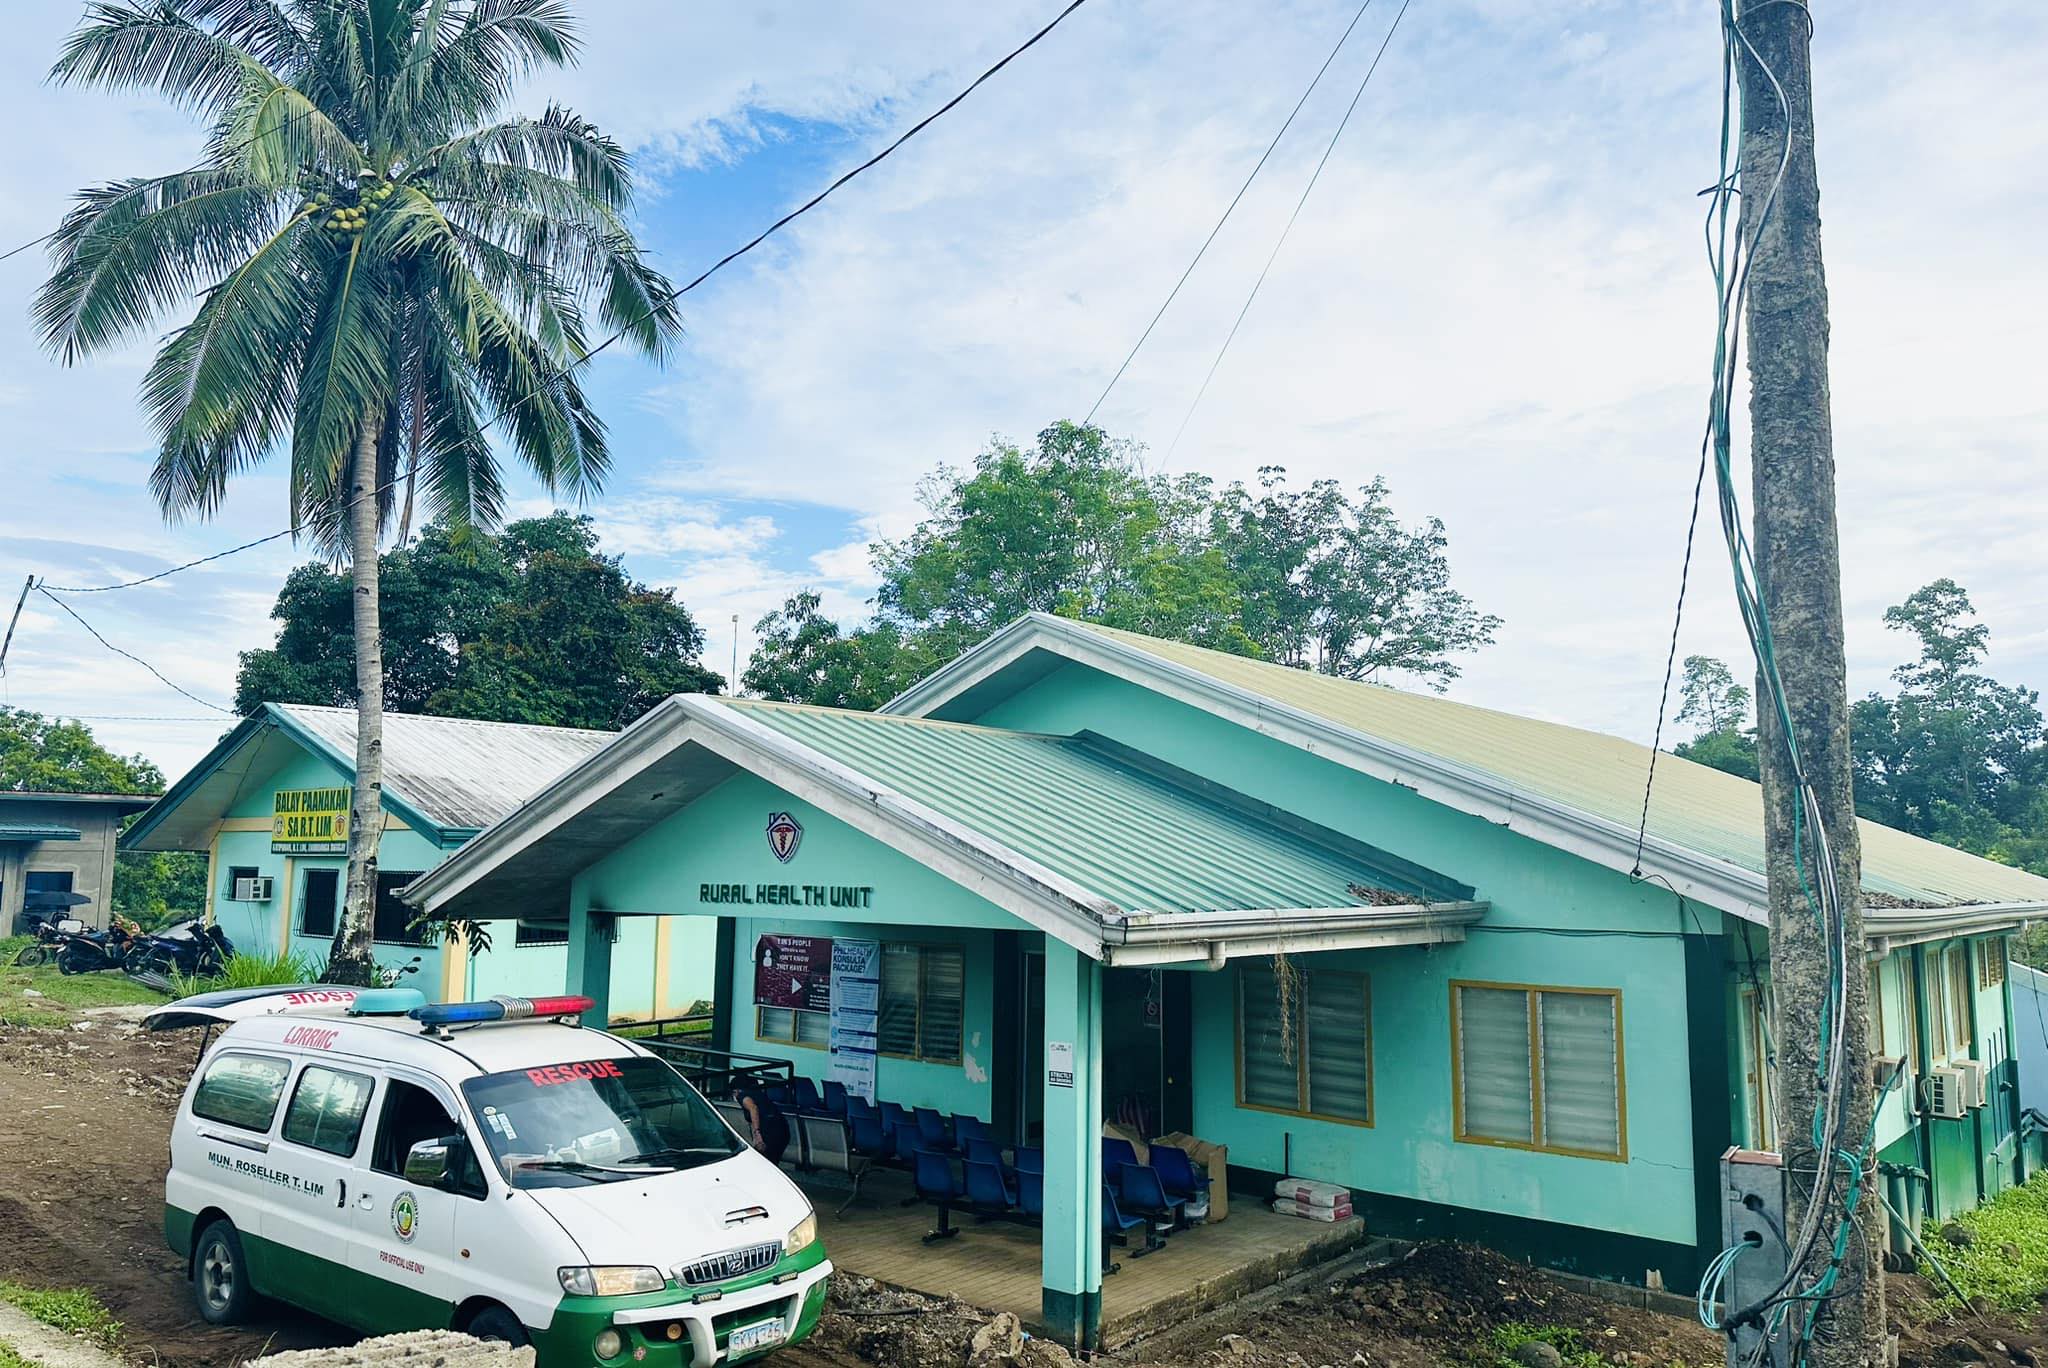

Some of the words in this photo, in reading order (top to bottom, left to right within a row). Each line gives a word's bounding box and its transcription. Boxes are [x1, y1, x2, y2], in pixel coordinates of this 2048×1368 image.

[276, 791, 301, 812] BALAY
[302, 789, 349, 812] PAANAKAN
[288, 817, 299, 837] SA
[300, 816, 314, 837] R.T.
[316, 816, 332, 837] LIM
[700, 884, 753, 903] RURAL
[756, 884, 826, 905] HEALTH
[830, 886, 874, 908] UNIT
[283, 991, 358, 1005] ESCUE
[526, 1060, 625, 1087] RESCUE
[208, 1152, 233, 1167] MUN.
[236, 1160, 290, 1183] ROSELLER
[292, 1176, 301, 1187] T.
[304, 1180, 324, 1195] LIM
